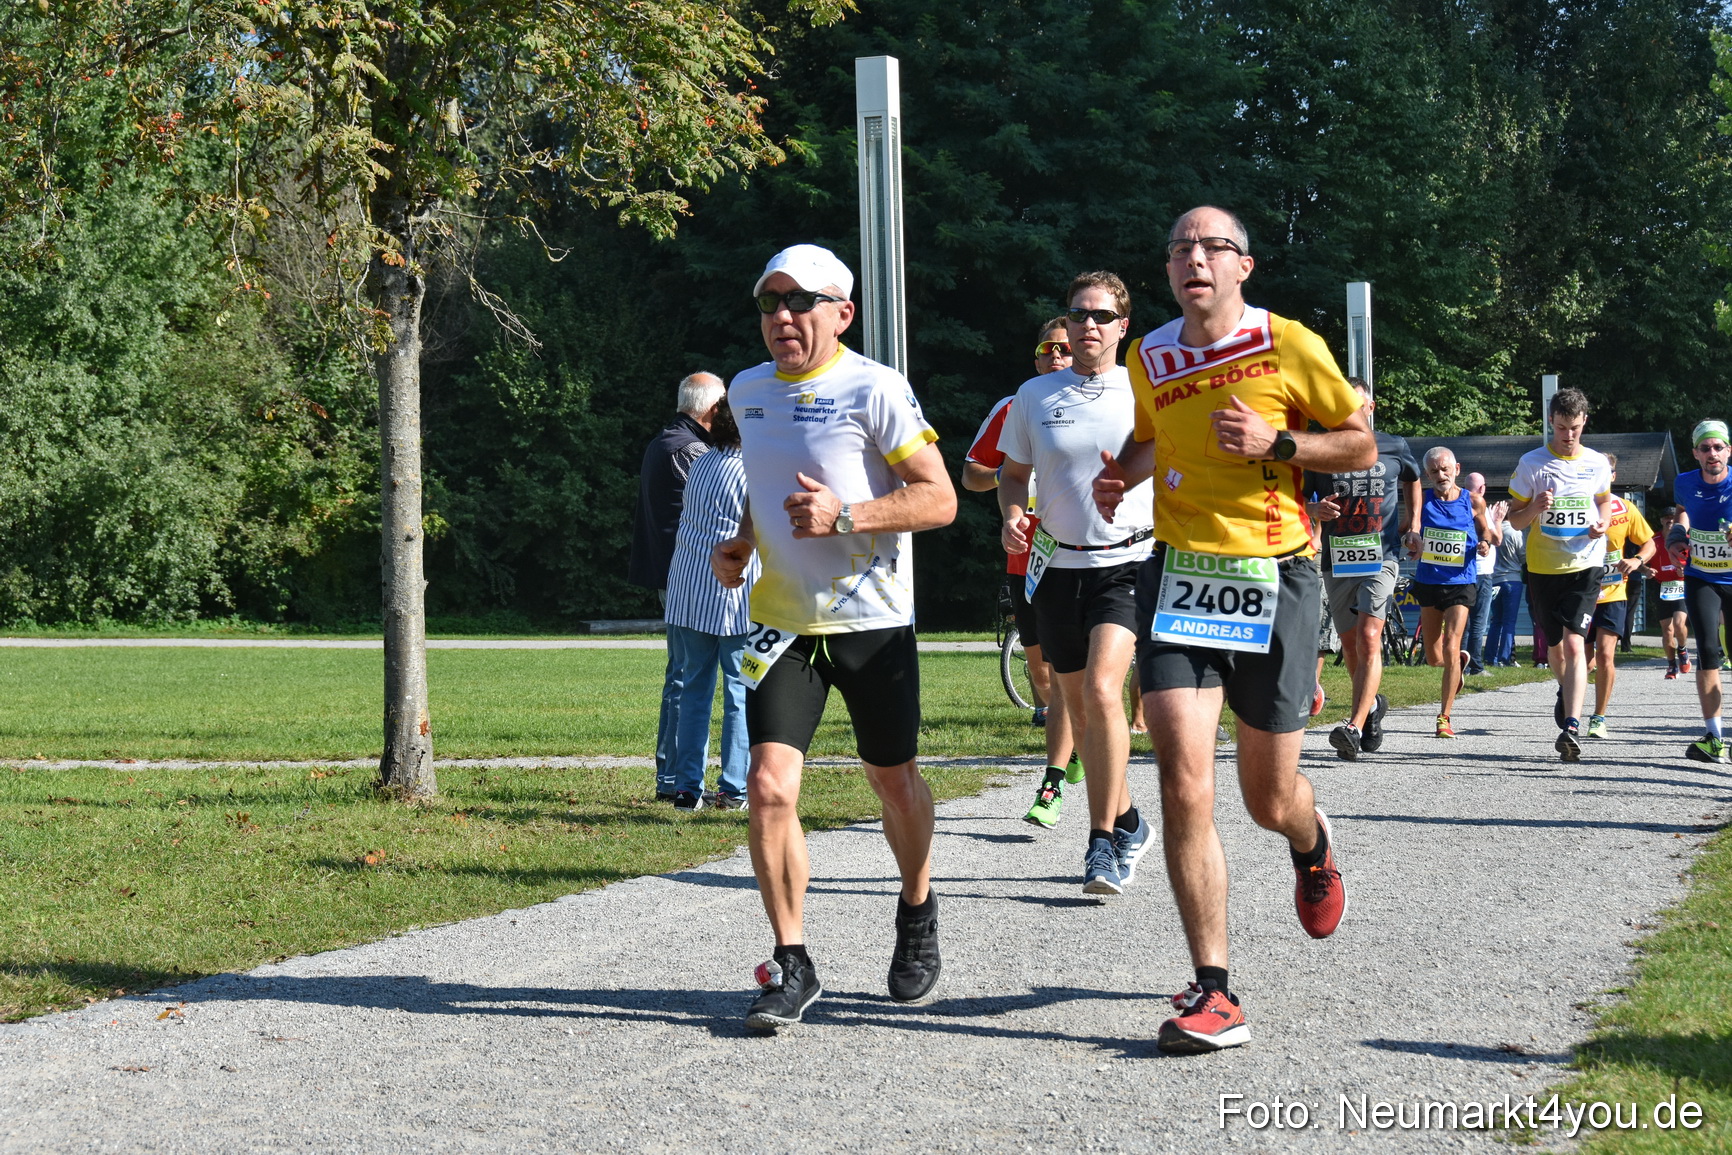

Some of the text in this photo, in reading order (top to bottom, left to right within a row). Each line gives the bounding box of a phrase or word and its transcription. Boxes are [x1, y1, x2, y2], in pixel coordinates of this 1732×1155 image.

[1154, 360, 1279, 412] MAX BÖGL
[794, 406, 838, 414] Neumarkter
[793, 415, 828, 424] Stadtlauf
[1332, 478, 1386, 498] DER
[1546, 511, 1586, 526] 2815
[1334, 536, 1376, 547] BOCK
[1427, 530, 1462, 540] BOCK
[1691, 530, 1726, 542] BOCK
[1428, 540, 1461, 554] 1006
[1693, 544, 1727, 559] 1134
[1337, 549, 1377, 562] 2825
[1175, 551, 1264, 577] BOCK
[847, 568, 873, 597] September
[1171, 581, 1264, 617] 2408
[1169, 619, 1255, 640] ANDREAS
